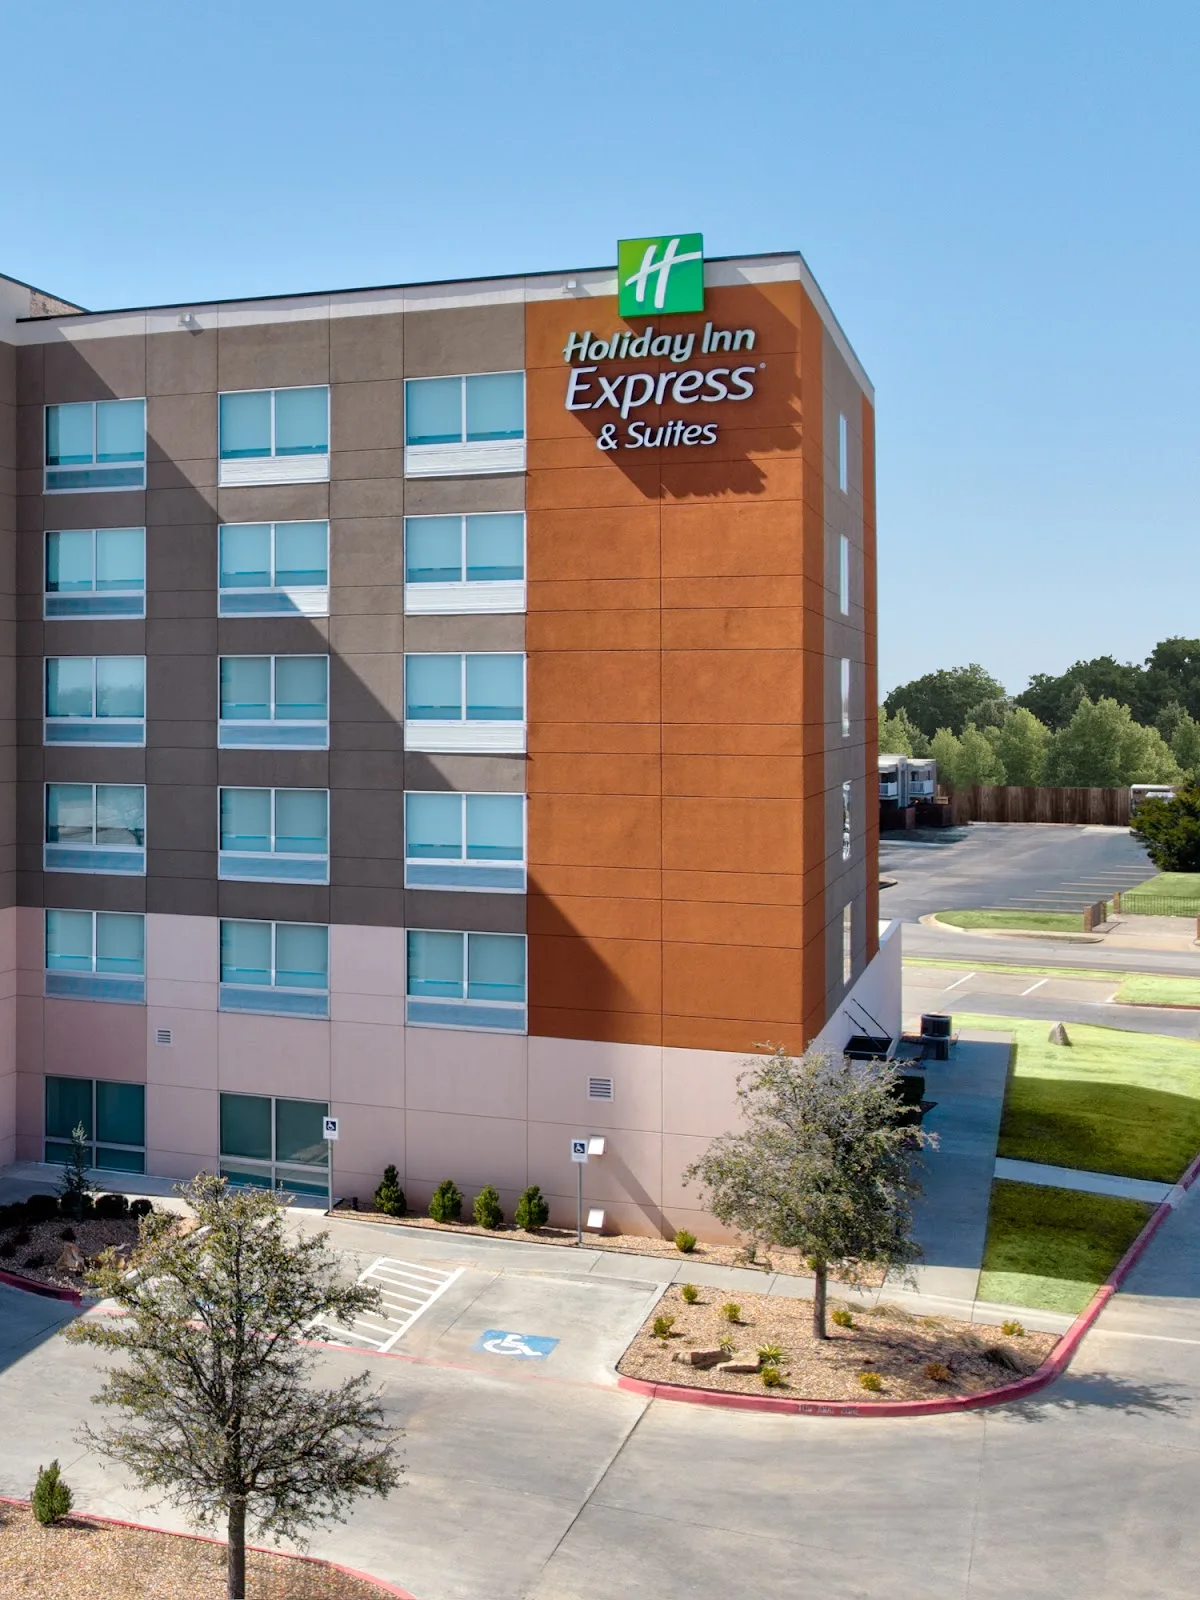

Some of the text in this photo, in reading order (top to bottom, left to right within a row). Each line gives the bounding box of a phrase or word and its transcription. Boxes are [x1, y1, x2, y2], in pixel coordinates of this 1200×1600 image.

[563, 321, 755, 362] Holiday Inn
[565, 365, 756, 419] Express
[597, 420, 718, 450] & Suites
